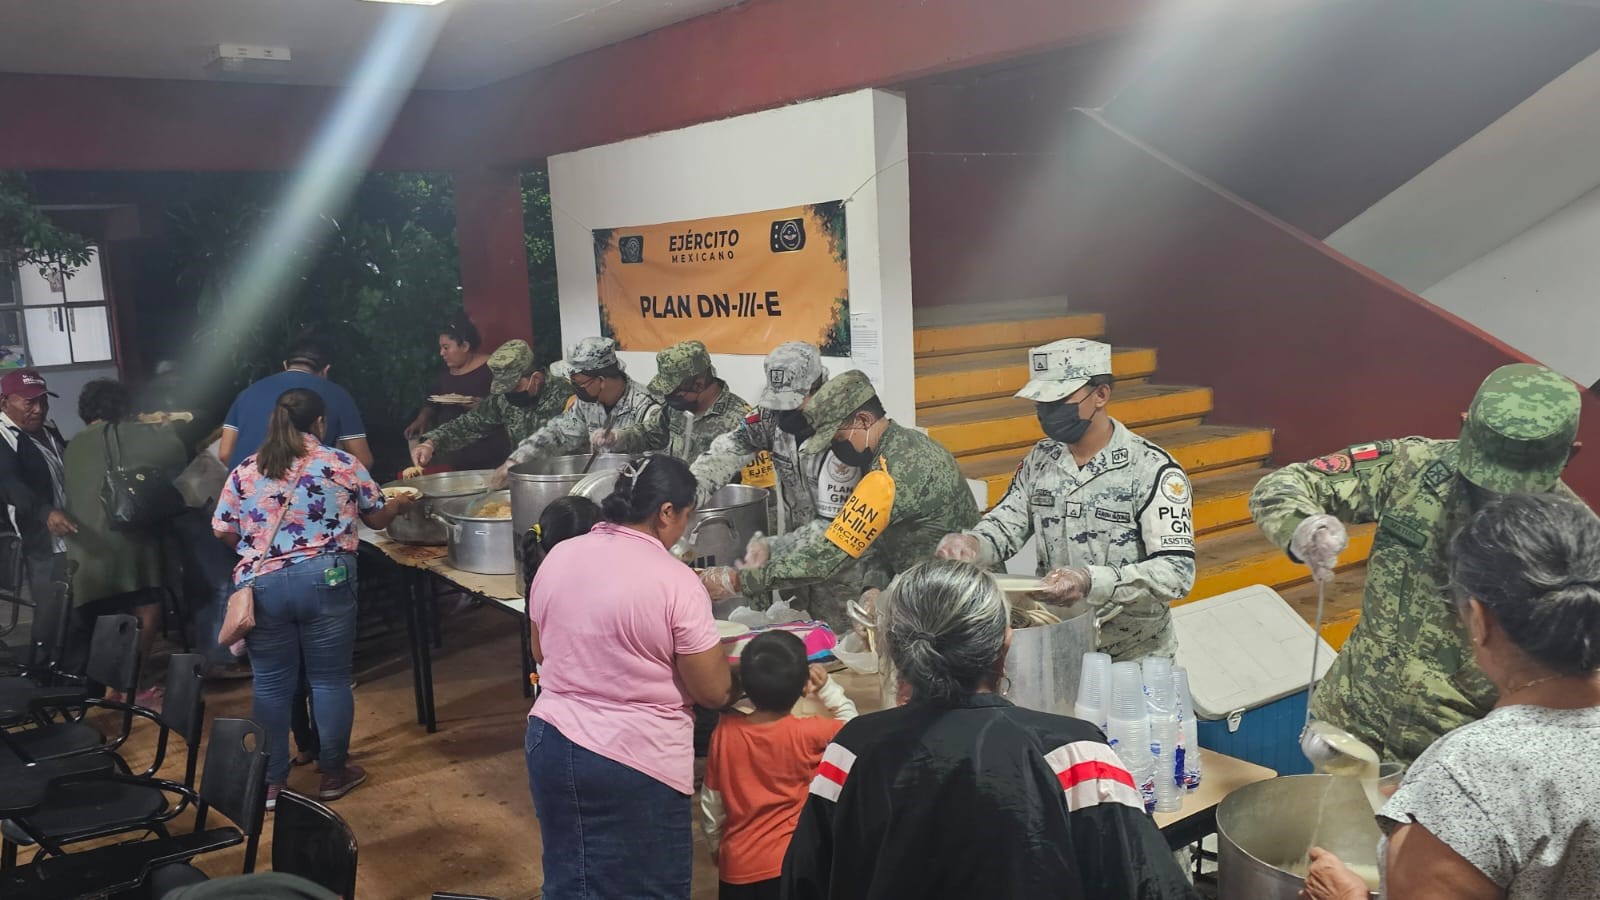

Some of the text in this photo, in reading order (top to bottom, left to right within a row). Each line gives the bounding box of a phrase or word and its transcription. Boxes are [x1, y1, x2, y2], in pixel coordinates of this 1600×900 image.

[669, 229, 739, 252] EJÉRCITO
[672, 251, 734, 263] MEXICANO
[640, 295, 692, 319] PLAN
[846, 495, 878, 523] PLAN
[1171, 520, 1192, 534] GN
